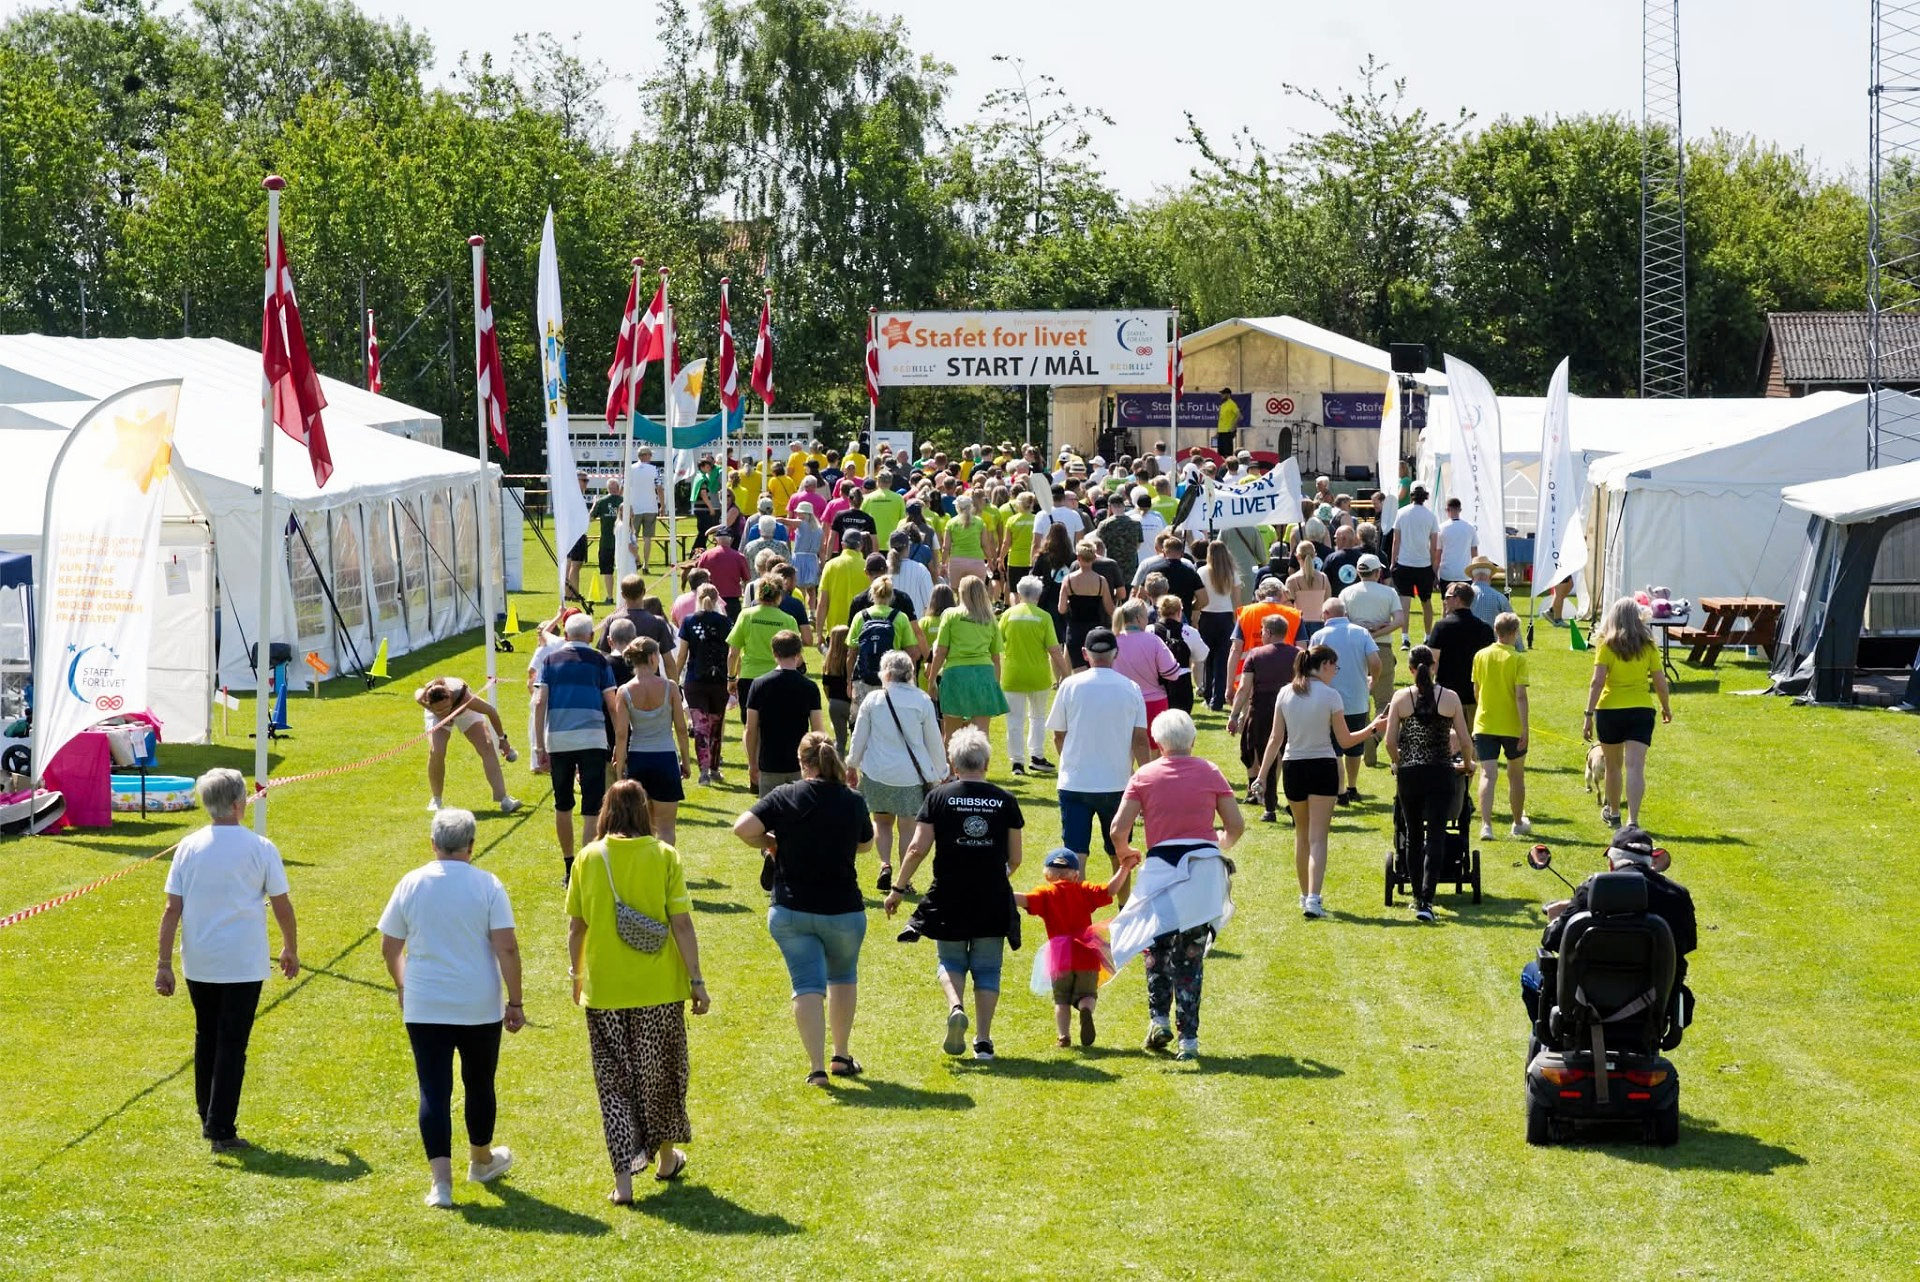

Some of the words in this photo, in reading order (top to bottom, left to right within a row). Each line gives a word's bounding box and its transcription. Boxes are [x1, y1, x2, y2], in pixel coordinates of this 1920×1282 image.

[914, 326, 987, 348] Stafet
[992, 326, 1028, 347] for
[1034, 326, 1088, 347] livet
[947, 356, 1024, 377] START
[1029, 356, 1039, 377] /
[1045, 349, 1099, 376] MÅL
[1202, 500, 1223, 520] FR
[1231, 493, 1279, 516] LIVET
[83, 667, 115, 677] STAFET
[82, 677, 100, 687] FOR
[101, 678, 127, 688] LIVET
[948, 796, 1004, 808] GRIBSKOV
